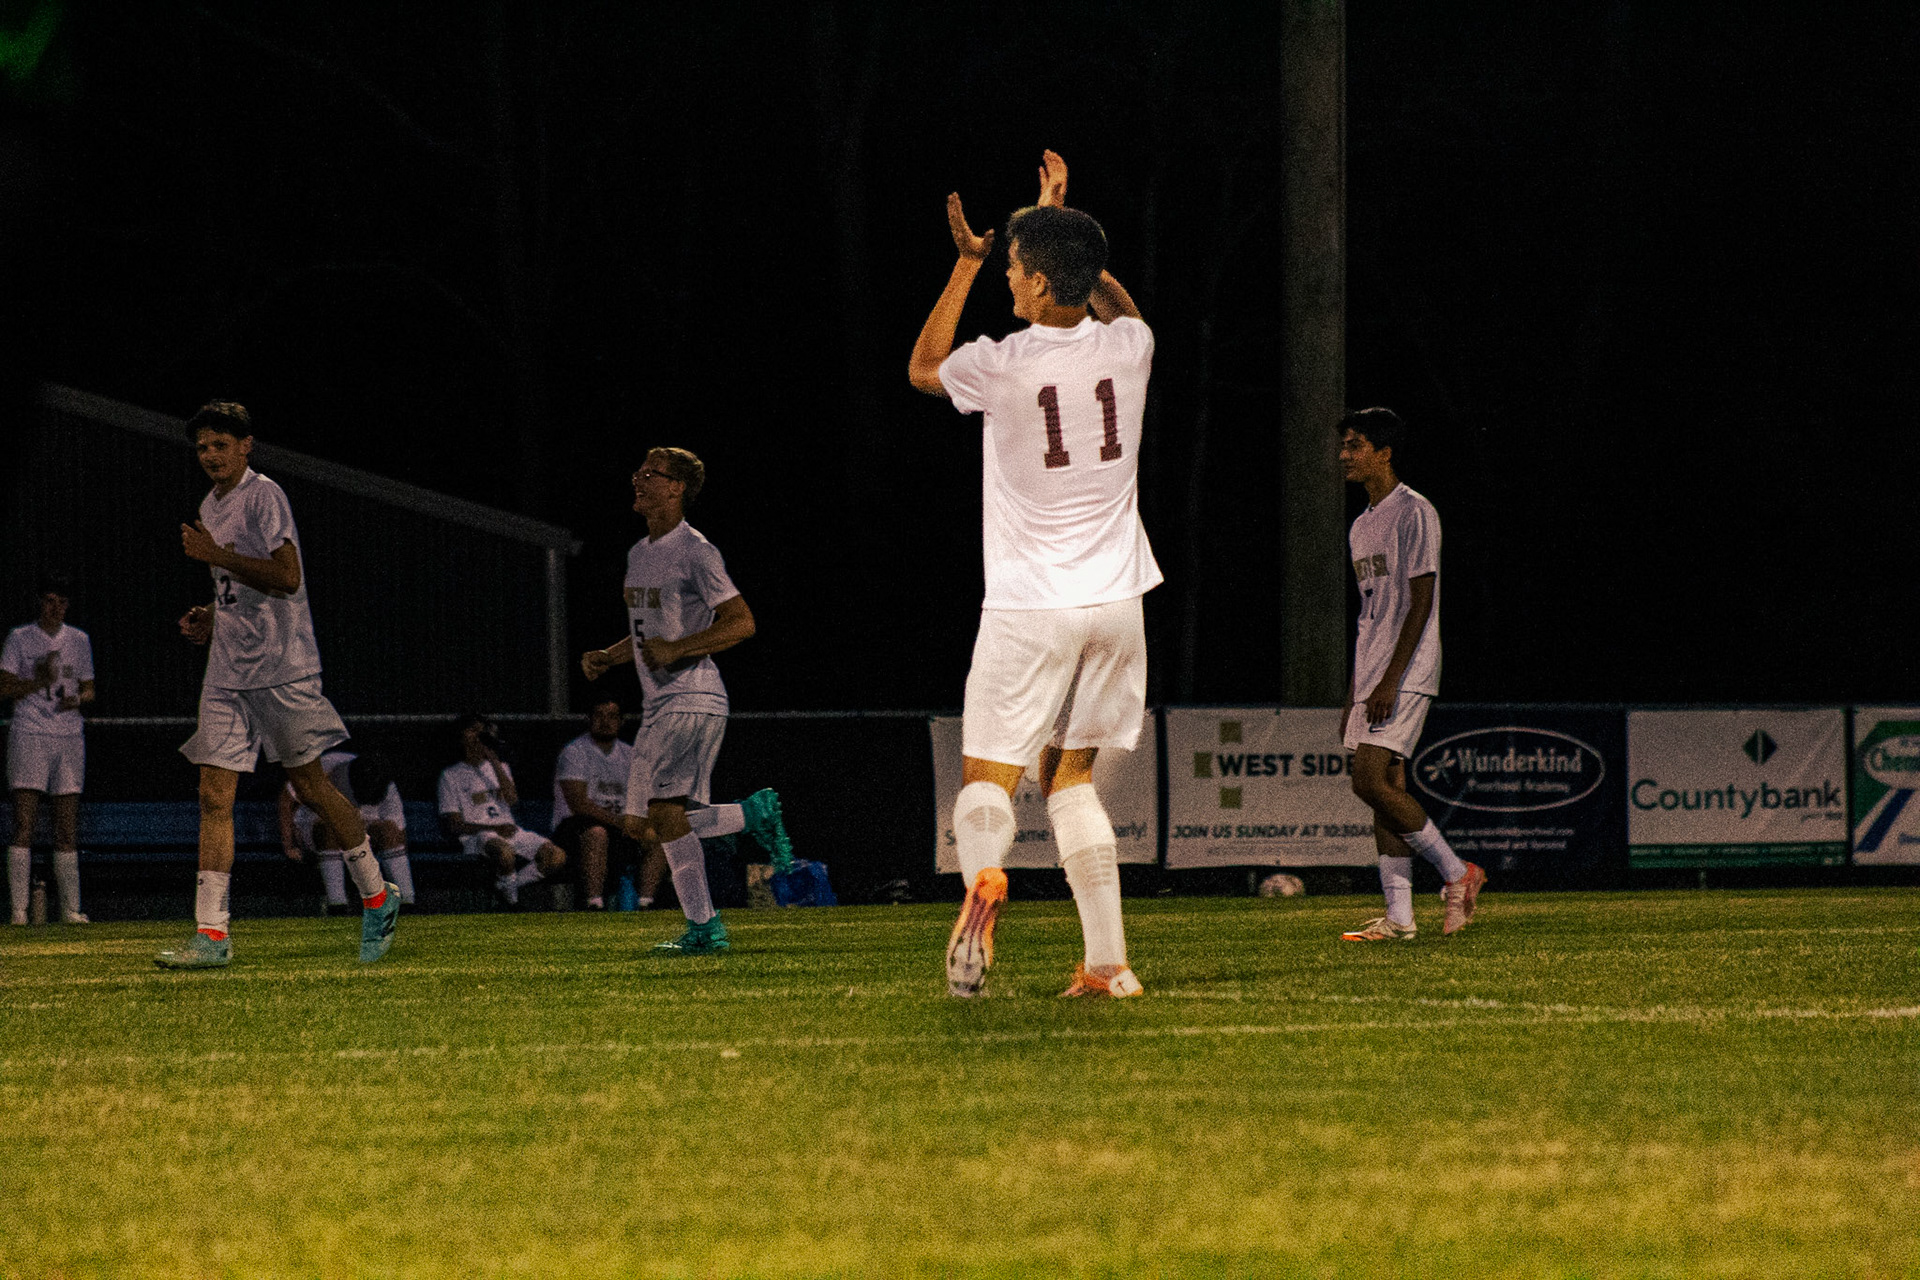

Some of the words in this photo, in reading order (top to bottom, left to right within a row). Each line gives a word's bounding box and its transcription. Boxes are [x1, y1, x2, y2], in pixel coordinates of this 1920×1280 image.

[1037, 378, 1122, 469] 11
[634, 619, 645, 649] 5
[1217, 753, 1294, 776] WEST
[1457, 748, 1582, 773] Wunderkind
[1631, 778, 1841, 820] Countybank
[1013, 829, 1050, 843] ame
[1114, 821, 1147, 841] arly!
[1174, 825, 1208, 839] JOIN
[1212, 825, 1232, 839] US
[1235, 824, 1298, 838] SUNDAY
[1300, 824, 1320, 838] AT
